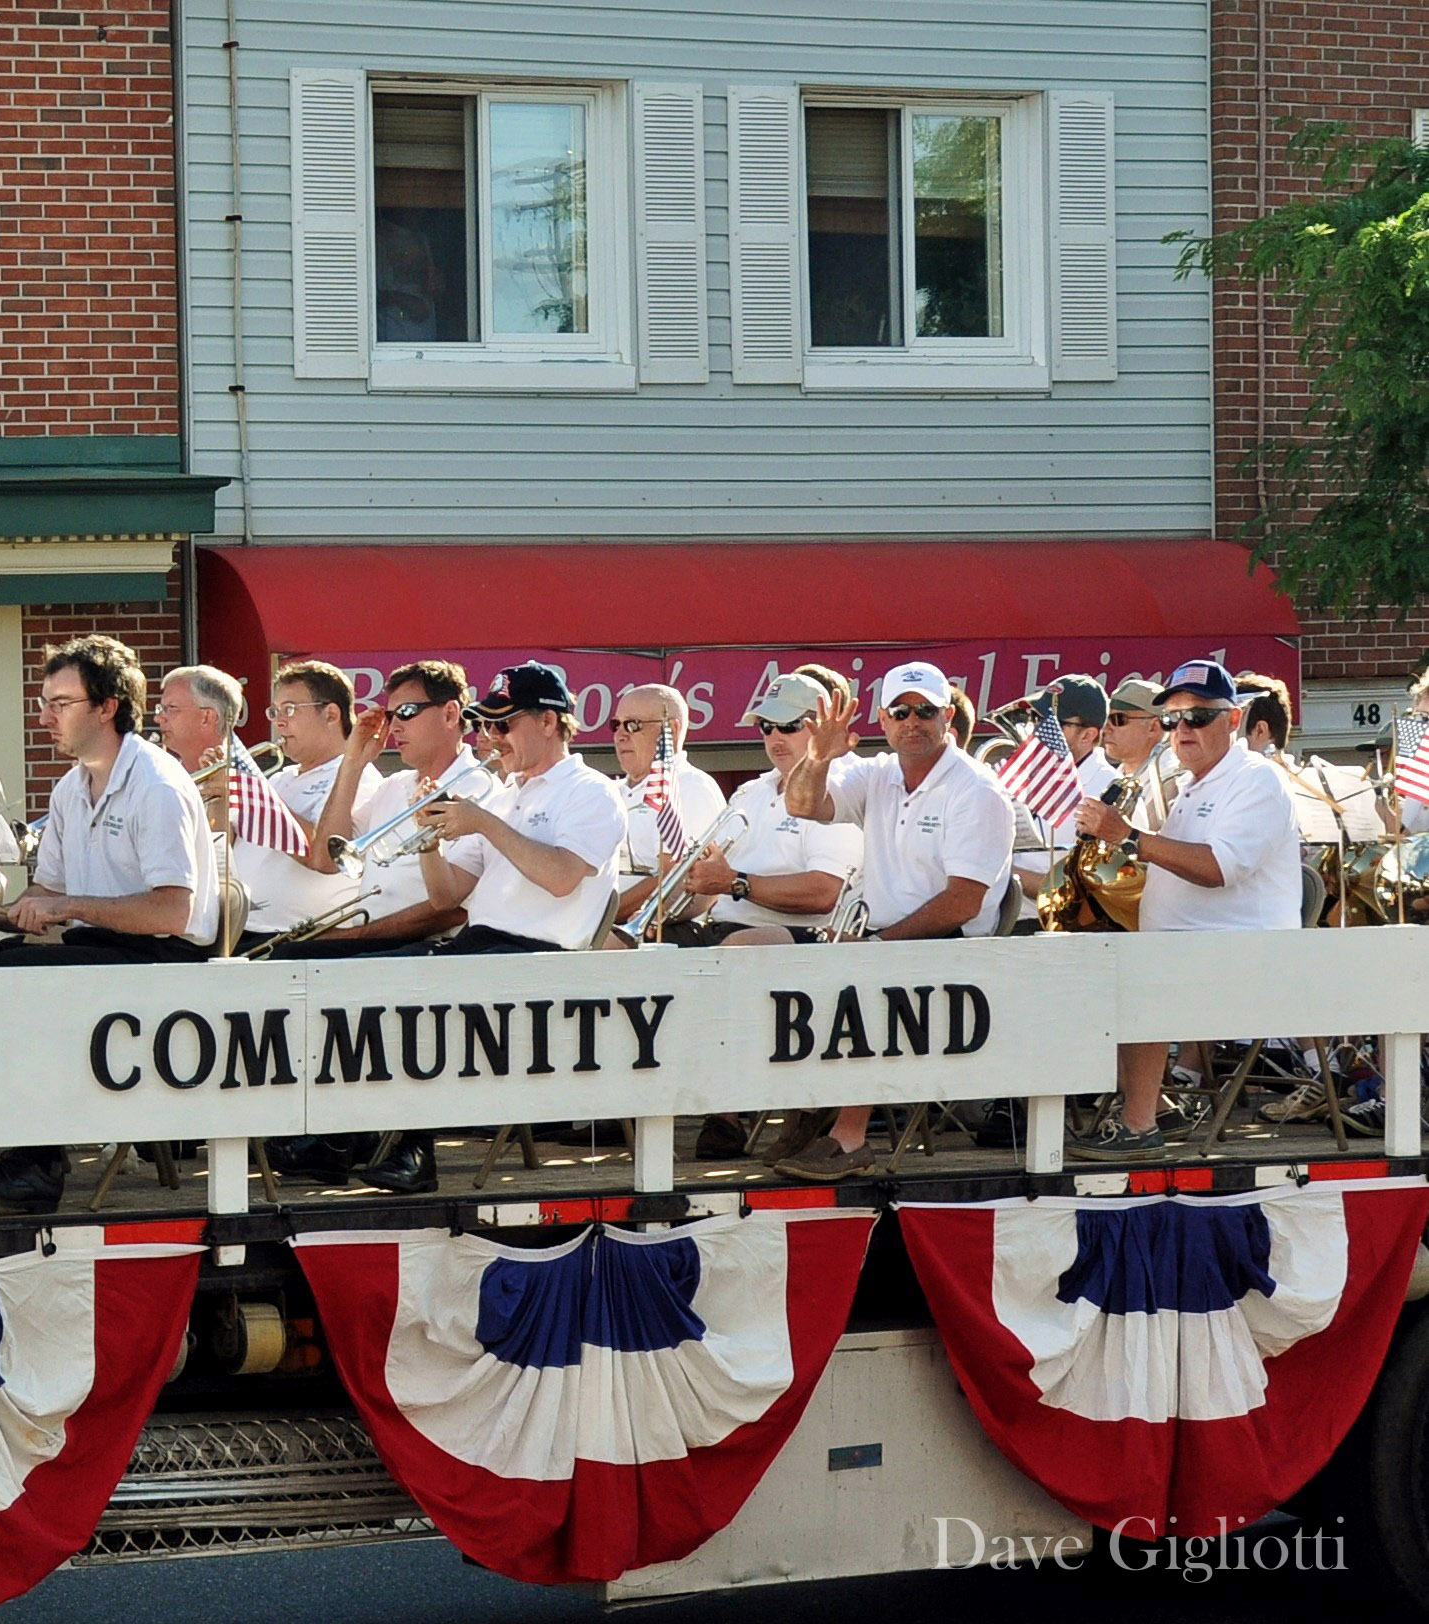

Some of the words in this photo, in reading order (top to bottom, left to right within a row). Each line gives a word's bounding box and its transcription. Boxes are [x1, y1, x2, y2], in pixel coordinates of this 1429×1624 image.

[1353, 703, 1381, 726] 48
[88, 995, 675, 1092] COMMUNITY
[768, 984, 992, 1063] BAND
